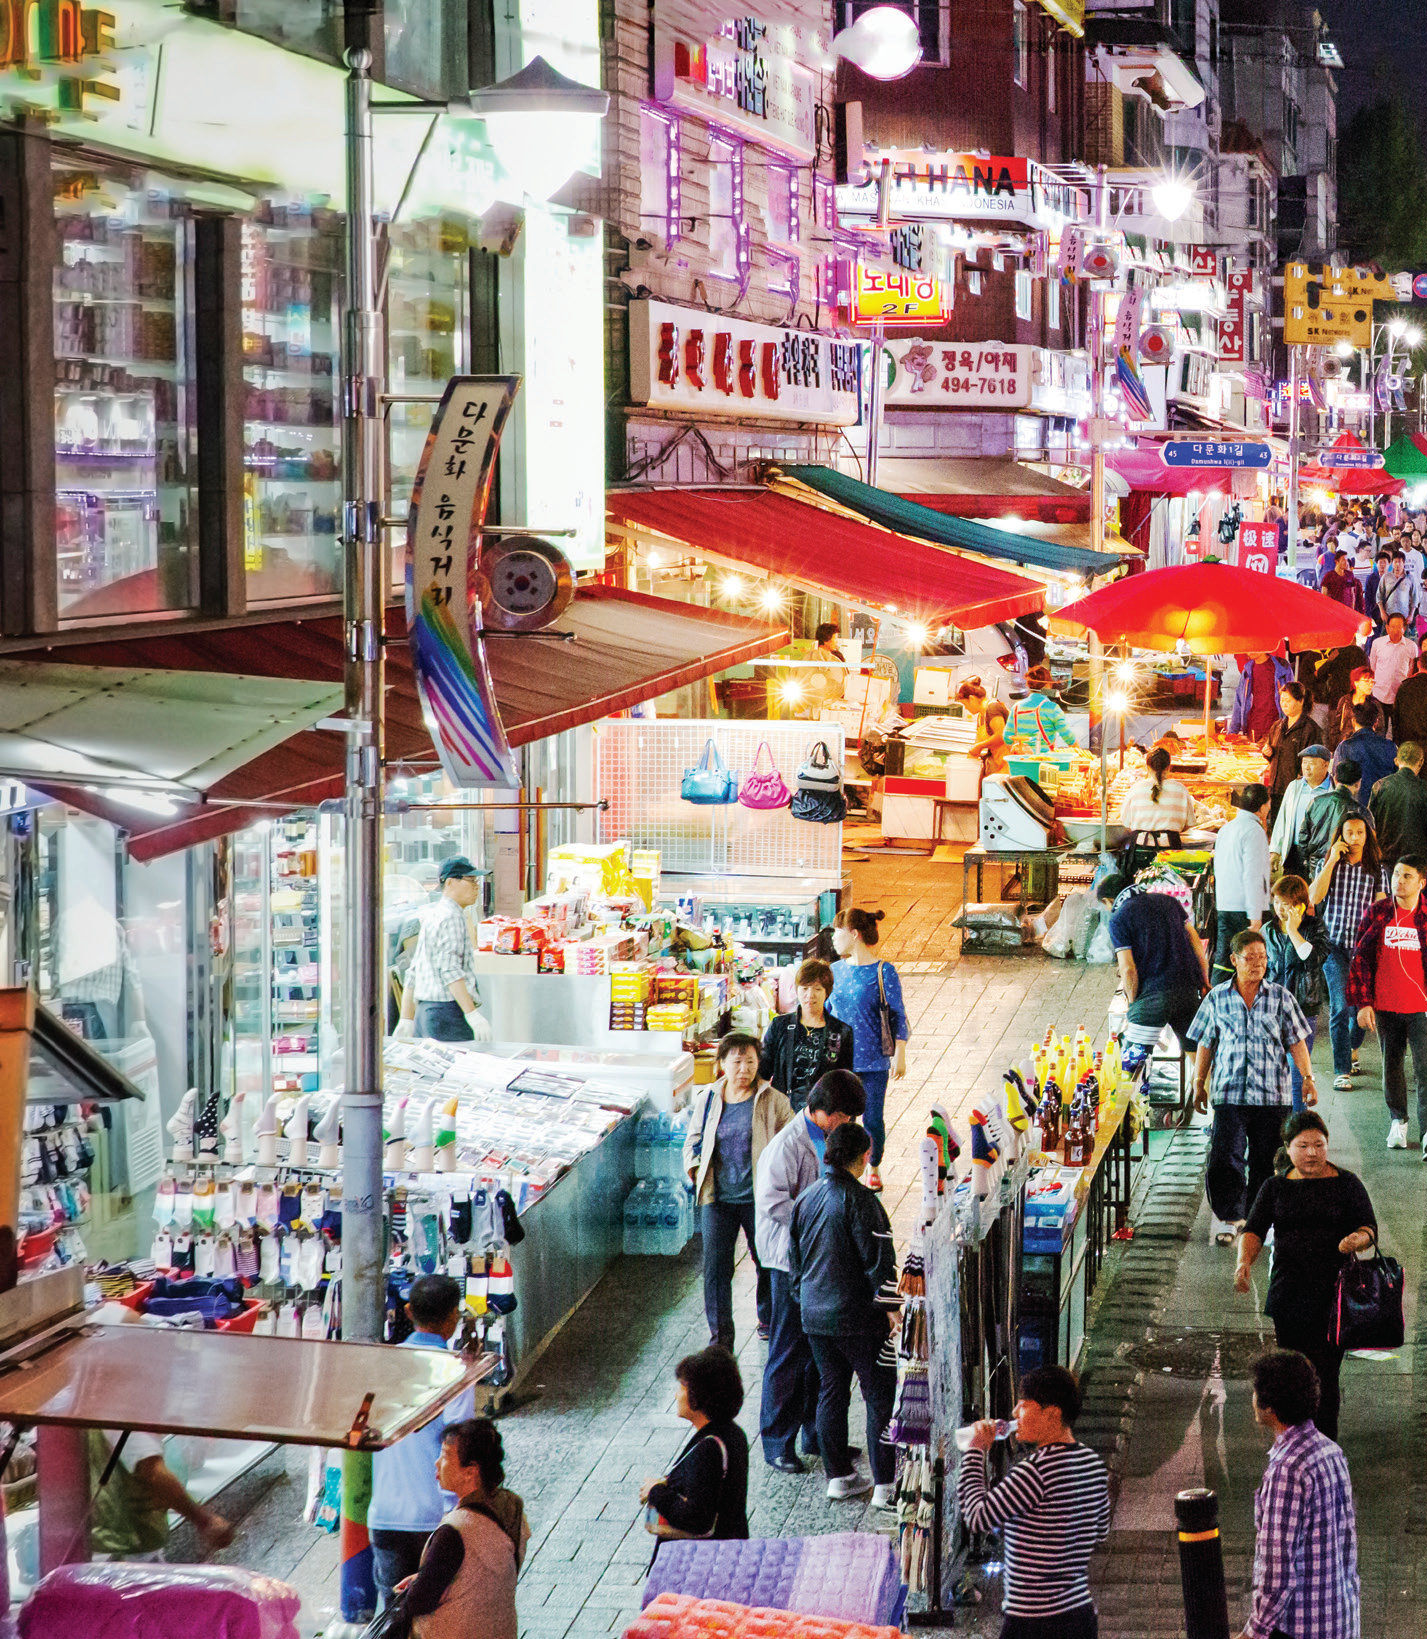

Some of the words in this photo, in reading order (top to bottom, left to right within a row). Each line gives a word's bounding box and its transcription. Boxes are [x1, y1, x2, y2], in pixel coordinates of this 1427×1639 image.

[941, 377, 1017, 395] 494-7618
[444, 401, 488, 480] 다문화
[1168, 450, 1177, 458] 45
[1259, 451, 1268, 459] 43
[429, 493, 456, 606] 음식거리
